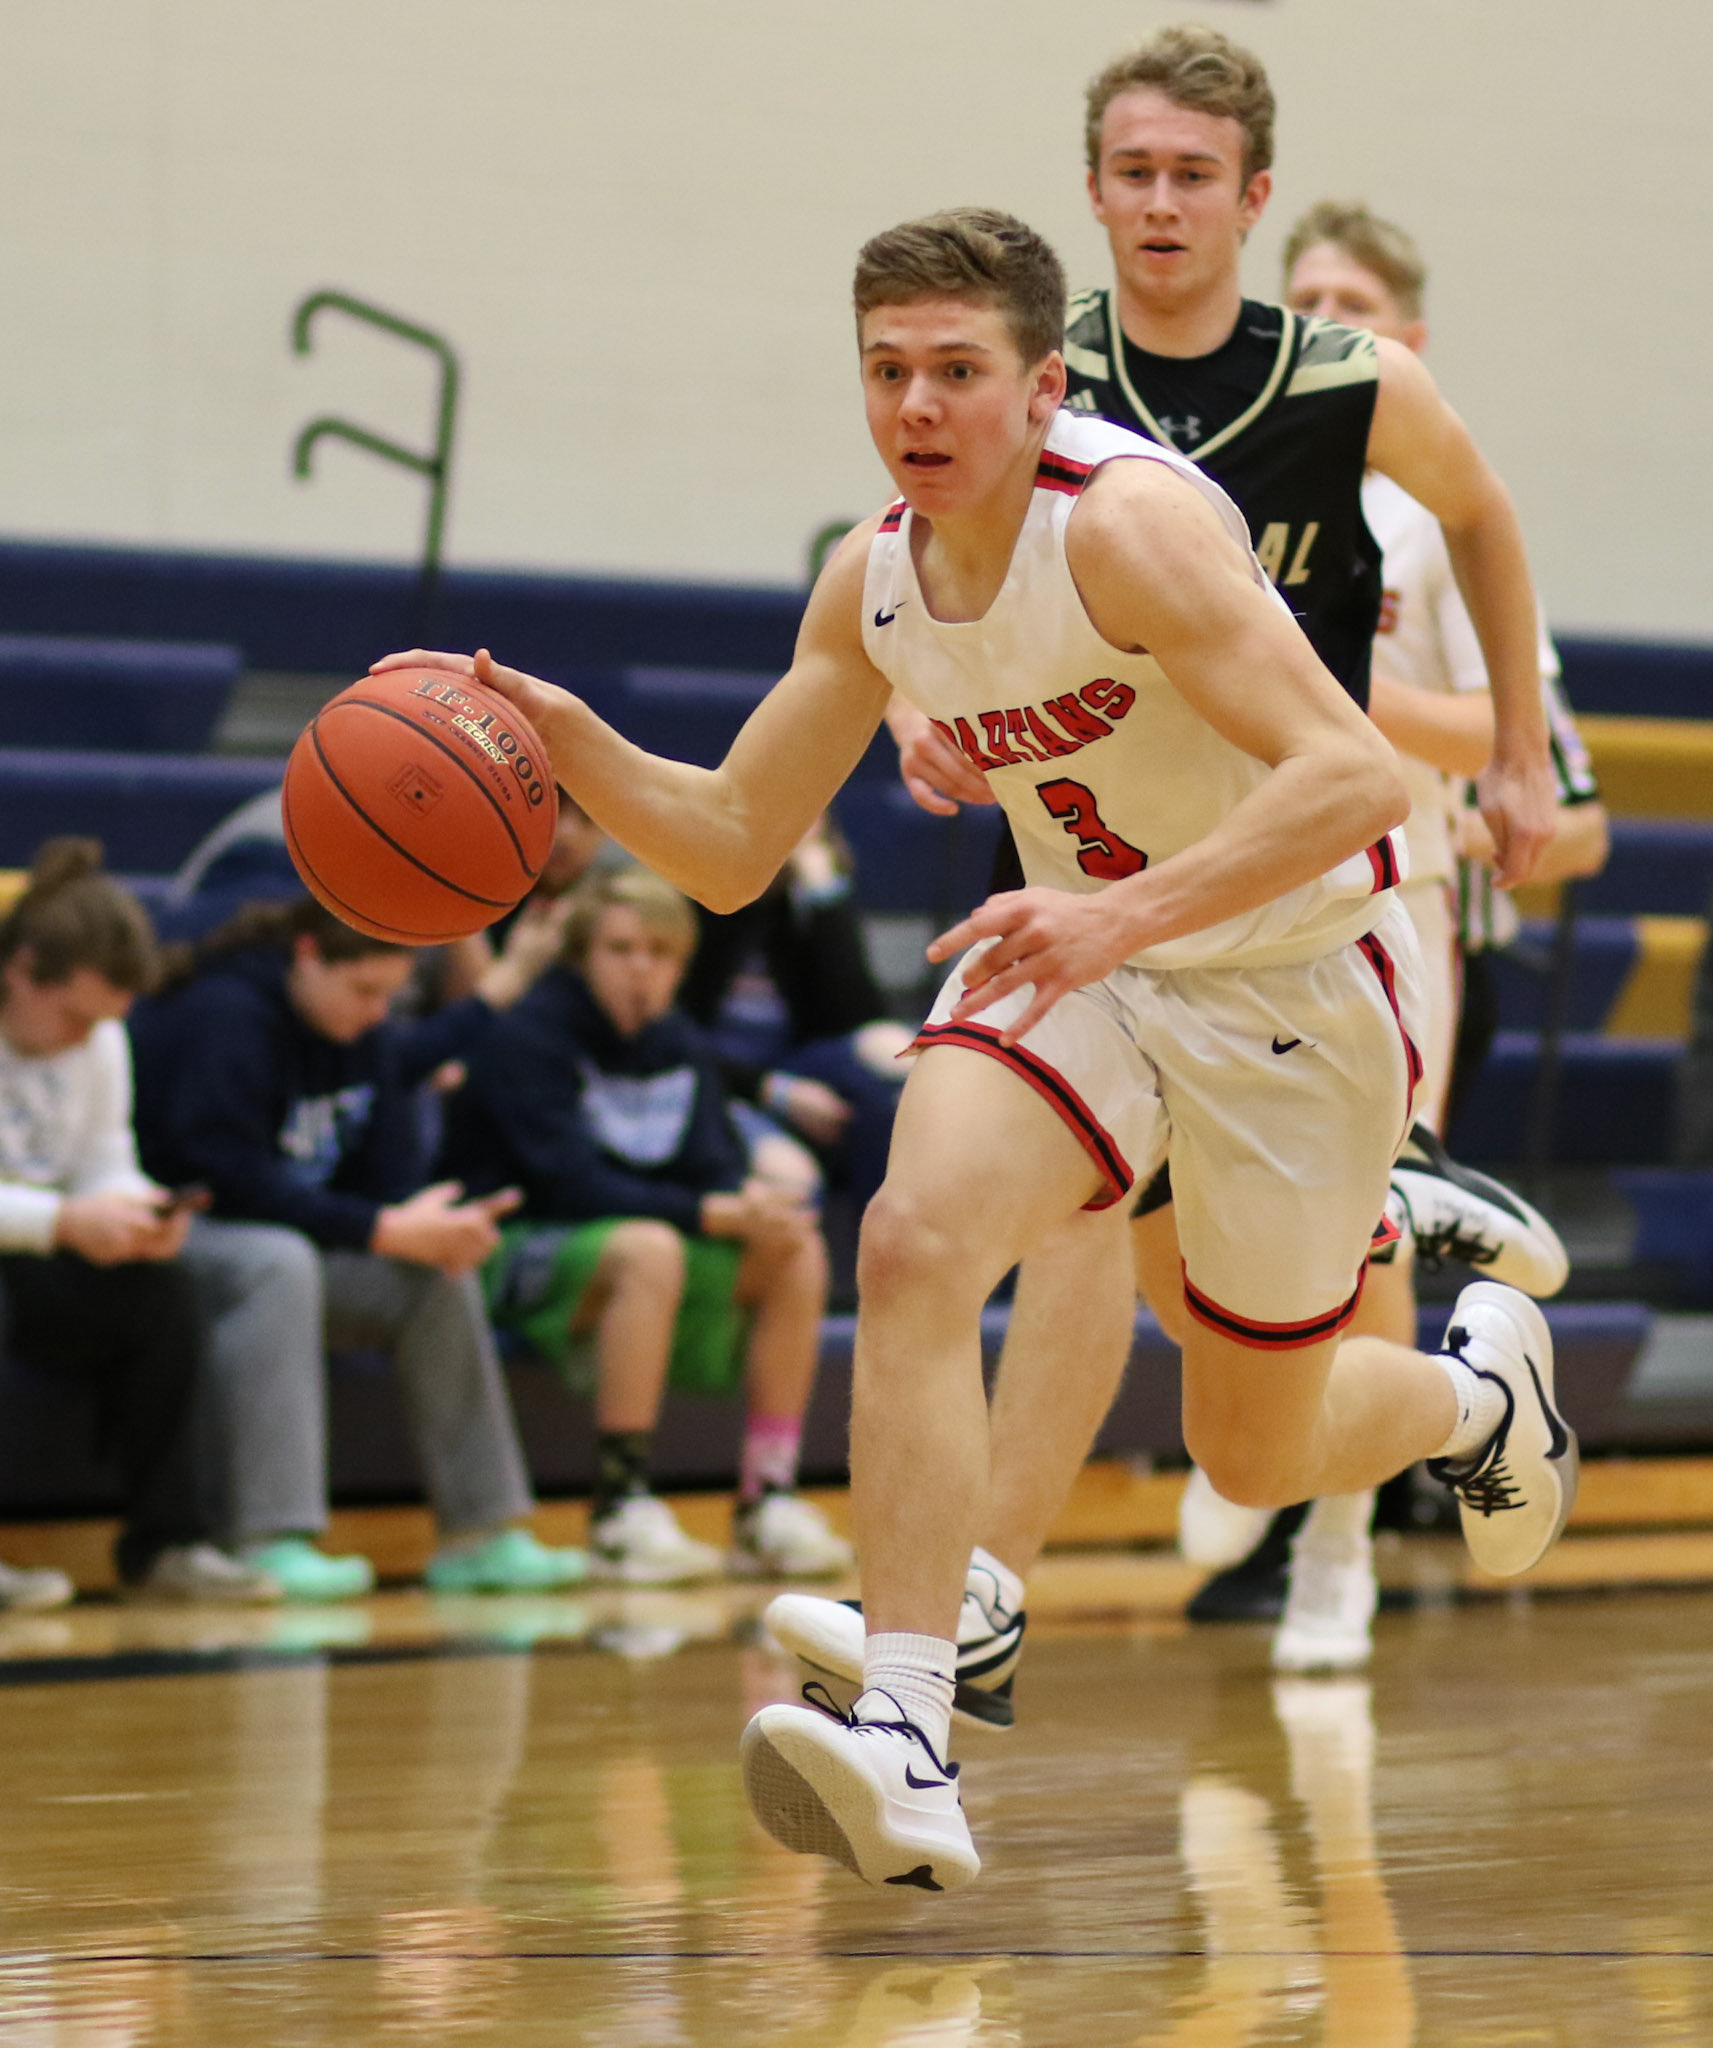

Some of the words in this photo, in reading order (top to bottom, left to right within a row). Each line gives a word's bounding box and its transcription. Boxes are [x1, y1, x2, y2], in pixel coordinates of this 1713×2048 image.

[415, 679, 544, 806] TF-1000
[451, 713, 510, 764] LEGACY
[1035, 777, 1149, 880] 3
